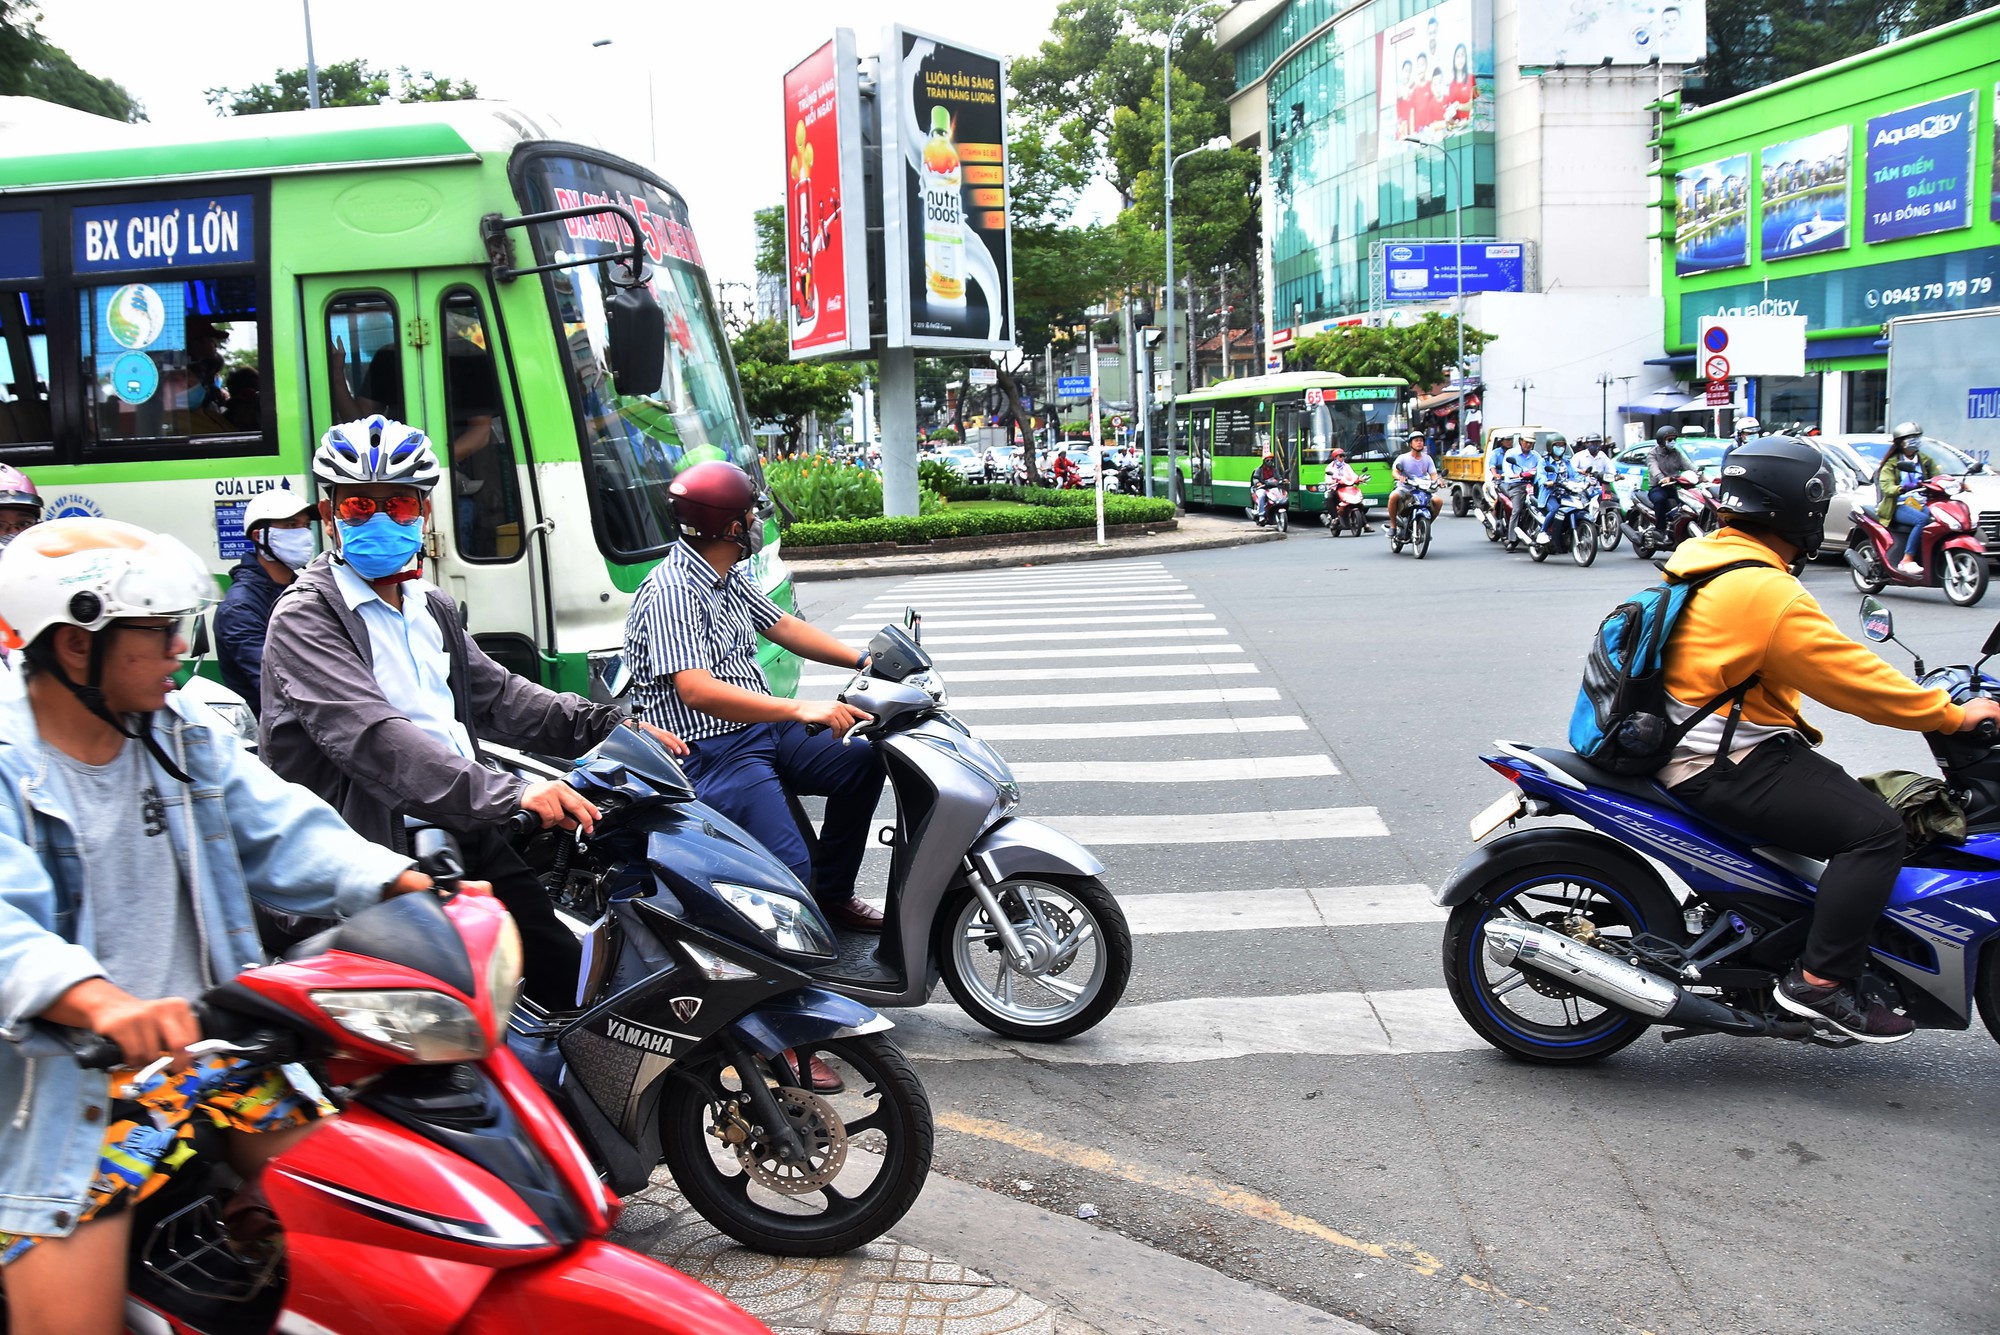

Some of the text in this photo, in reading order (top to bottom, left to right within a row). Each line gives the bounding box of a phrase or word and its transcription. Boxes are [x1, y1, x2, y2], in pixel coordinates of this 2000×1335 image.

[926, 70, 951, 86] LUÔN
[971, 74, 995, 90] SÀNG
[1873, 156, 1934, 184] TÂM ĐIỂM
[927, 190, 959, 208] nutri
[1873, 199, 1957, 226] TẠI ĐỒNG NAI
[928, 203, 960, 224] boost
[86, 200, 238, 264] BX CHỢ LỚN
[630, 195, 663, 265] 5
[1882, 277, 1992, 305] 0943 79 79 79
[1308, 391, 1321, 404] 65
[1614, 814, 1753, 869] EXCITER GP
[1886, 906, 1975, 942] 150
[606, 1018, 673, 1054] YAMAHA
